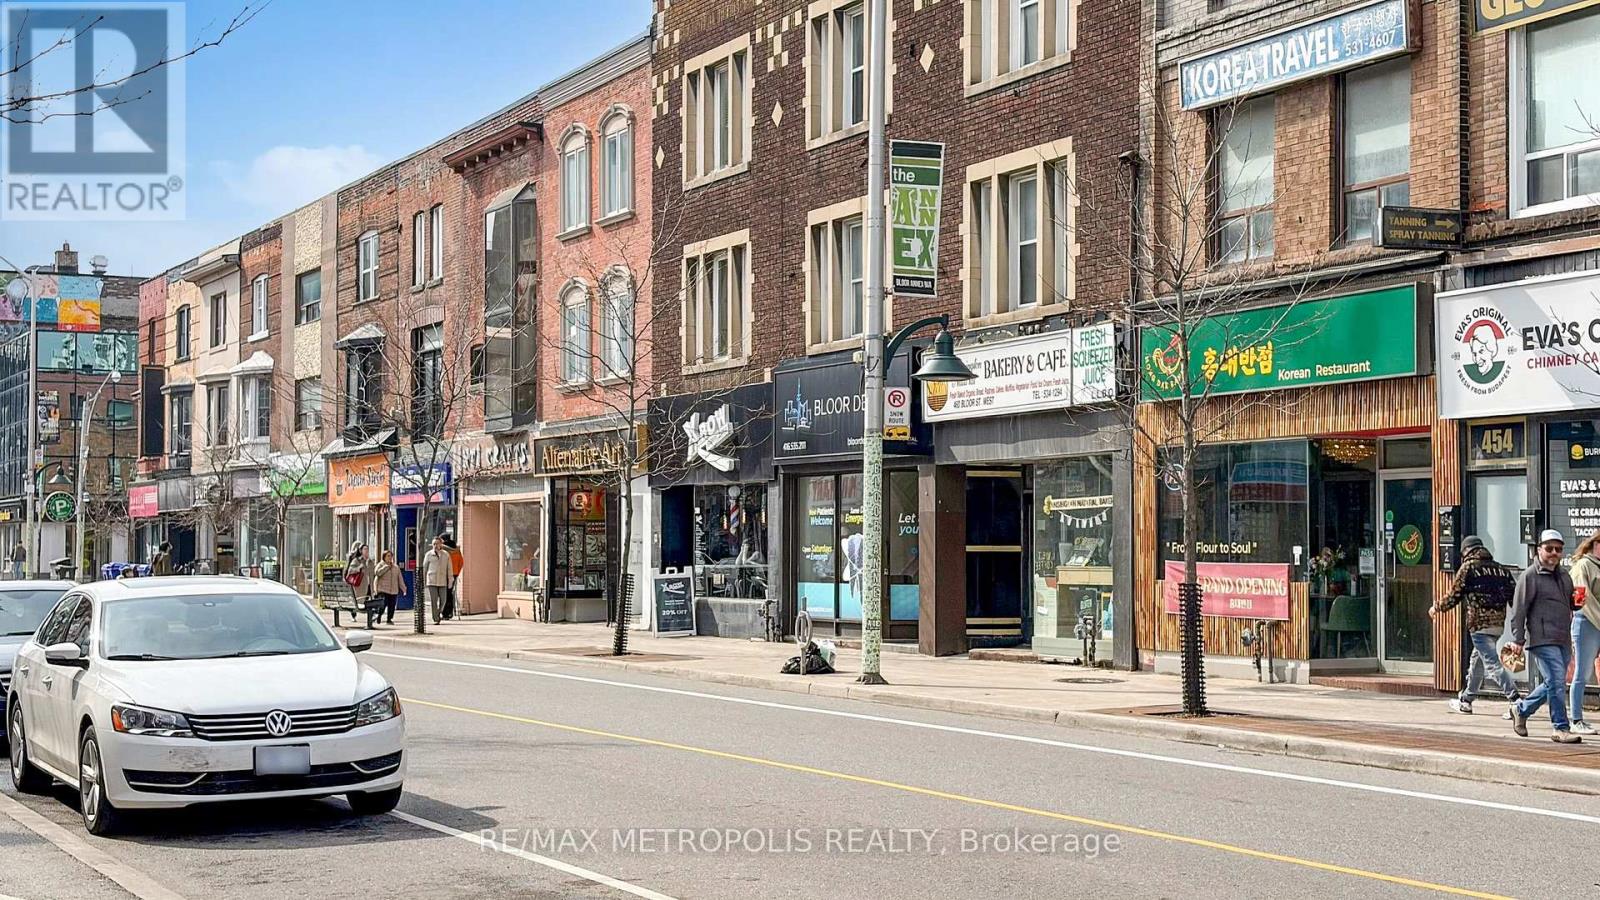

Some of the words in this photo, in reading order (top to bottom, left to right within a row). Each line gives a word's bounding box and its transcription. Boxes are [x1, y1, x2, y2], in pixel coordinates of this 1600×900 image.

[1345, 29, 1395, 56] 531-4607
[1190, 53, 1257, 98] KOREA
[1259, 26, 1339, 79] TRAVEL
[893, 168, 915, 183] the
[1389, 216, 1427, 227] TANNING
[1389, 229, 1417, 240] SPRAY
[1418, 231, 1456, 241] TANNING
[1455, 315, 1472, 342] EVA'S
[1472, 307, 1512, 336] ORIGINAL
[1080, 328, 1106, 348] FRESH
[1522, 321, 1581, 351] EVA'S
[984, 355, 1025, 379] BAKERY
[1026, 354, 1035, 374] &
[1073, 346, 1114, 368] SQUEEZED
[1527, 354, 1579, 369] CHIMNEY
[1083, 365, 1106, 385] JUICE
[1278, 367, 1311, 381] Korean
[1315, 360, 1371, 376] Restaurant
[1457, 369, 1471, 390] FRESH
[1470, 386, 1487, 396] FROM
[1487, 364, 1512, 395] BUDAPEST
[814, 395, 850, 416] BLOOR
[961, 398, 975, 408] BLOOR
[1481, 428, 1514, 454] 454
[542, 443, 598, 469] Alternative
[1560, 480, 1587, 491] EVA'S
[1588, 480, 1597, 491] &
[810, 516, 833, 525] Welcome
[898, 513, 915, 523] Let
[1568, 508, 1580, 516] ICE
[1525, 523, 1530, 534] 4
[1172, 543, 1185, 553] Fro
[1196, 542, 1217, 553] Flour
[1220, 543, 1229, 553] to
[1231, 542, 1251, 553] Soul
[1444, 552, 1449, 562] 2
[1236, 577, 1287, 596] OPENING
